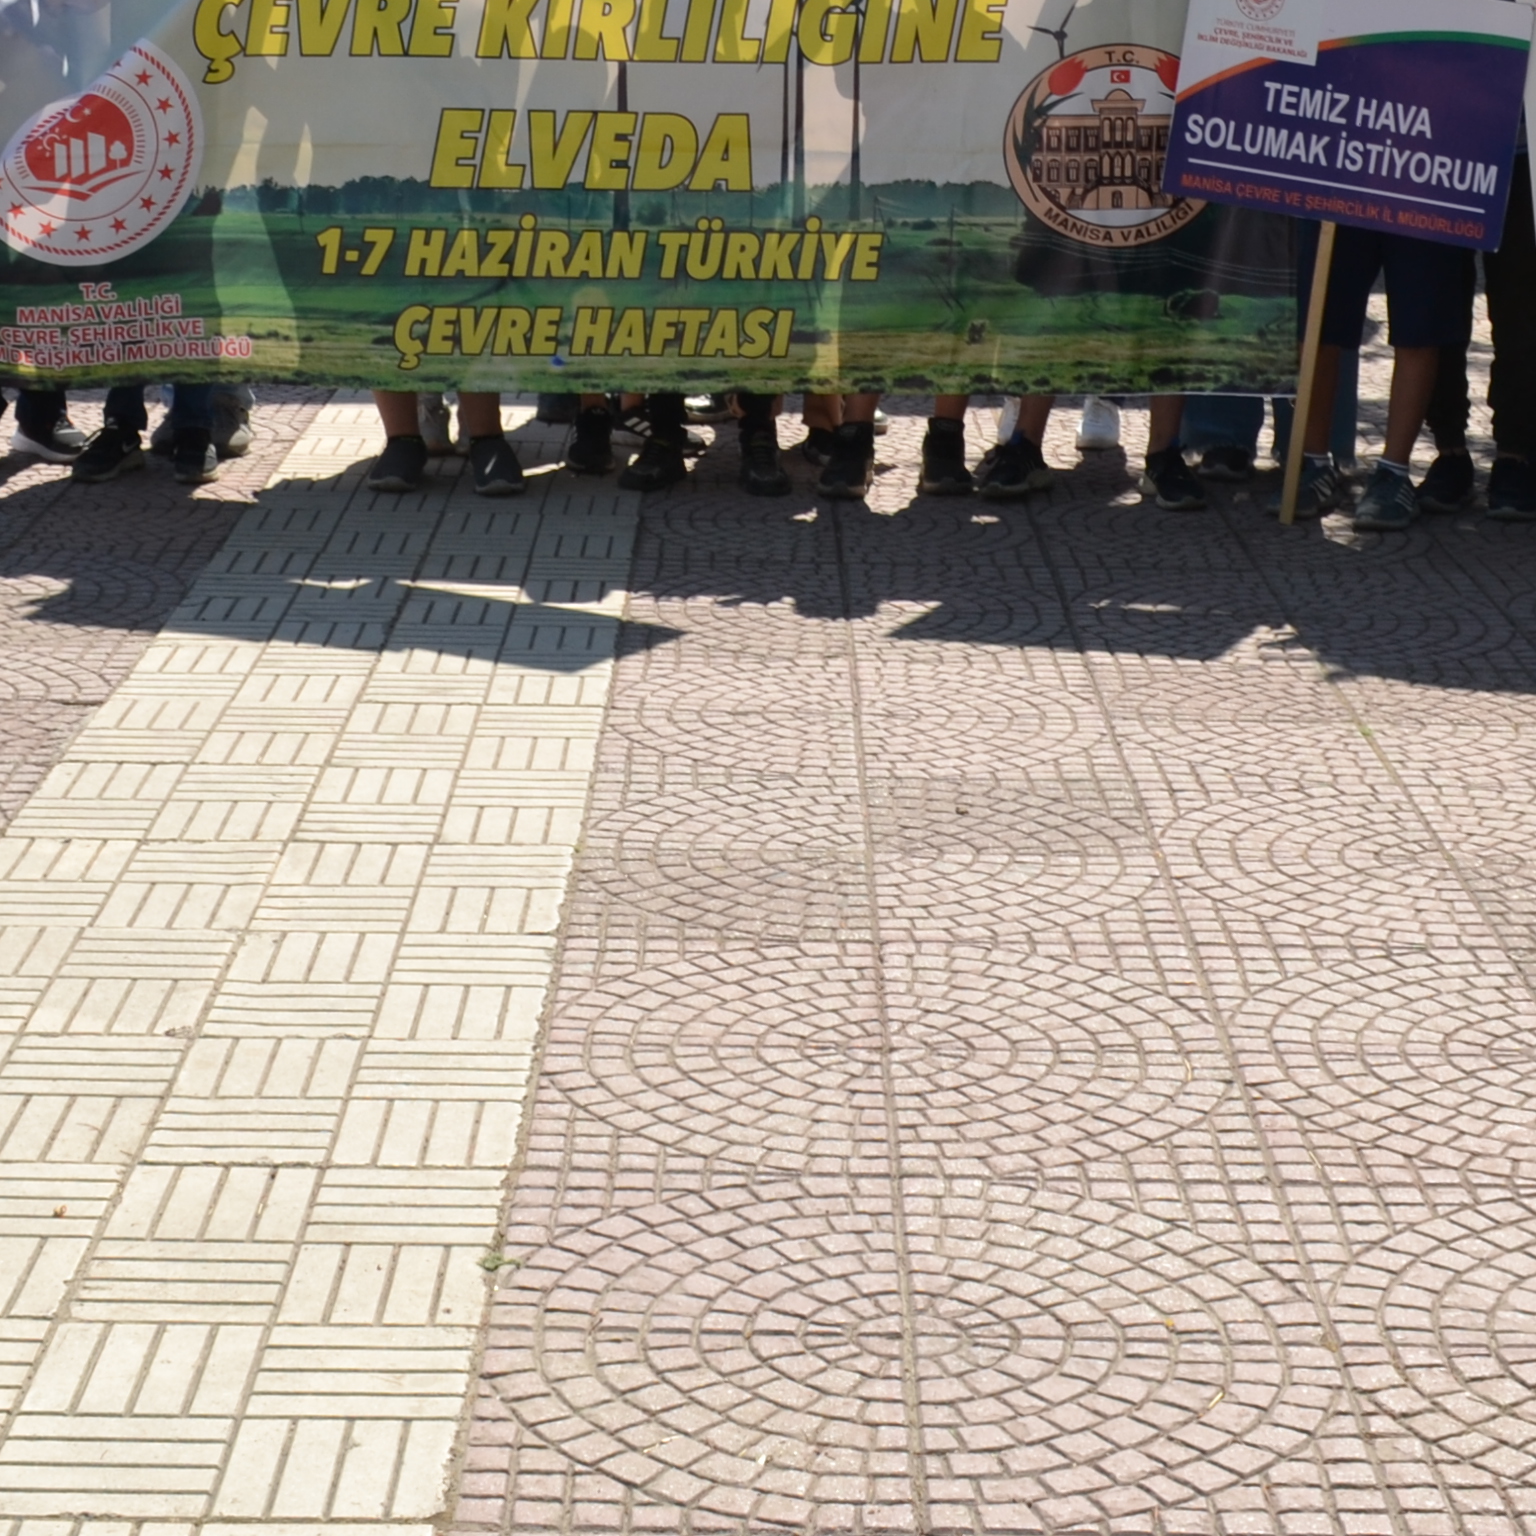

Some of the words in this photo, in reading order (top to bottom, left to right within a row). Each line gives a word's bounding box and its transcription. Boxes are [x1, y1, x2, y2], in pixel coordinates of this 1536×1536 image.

[1105, 50, 1140, 64] T.C.
[1284, 37, 1294, 46] VE
[1264, 81, 1350, 124] TEMİZ
[1355, 96, 1433, 139] HAVA
[429, 107, 753, 192] ELVEDA
[1185, 114, 1330, 167] SOLUMAK
[1336, 131, 1498, 195] İSTİYORUM
[1044, 207, 1114, 243] MANİSA
[1181, 174, 1232, 195] MANİSA
[1236, 183, 1280, 203] ÇEVRE
[1285, 189, 1300, 206] VE
[1305, 191, 1381, 220] ŞEHİRCİLİK
[1382, 204, 1394, 223] İL
[1398, 205, 1484, 240] MÜDÜRLÜĞÜ
[315, 226, 395, 276] 1-7
[402, 212, 648, 279] HAZİRAN
[657, 214, 885, 282] TÜRKİYE
[79, 282, 116, 300] T.C.
[17, 303, 97, 325] MANİSA
[98, 294, 182, 320] VALİLİĞİ
[0, 327, 66, 348] ÇEVRE,
[68, 316, 172, 346] ŞEHİRCİLİK
[174, 318, 204, 338] VE
[393, 305, 562, 369] ÇEVRE
[569, 305, 795, 359] HAFTASI
[8, 344, 124, 371] DEĞİŞİKLİĞİ
[125, 335, 253, 360] MÜDÜRLÜĞÜ
